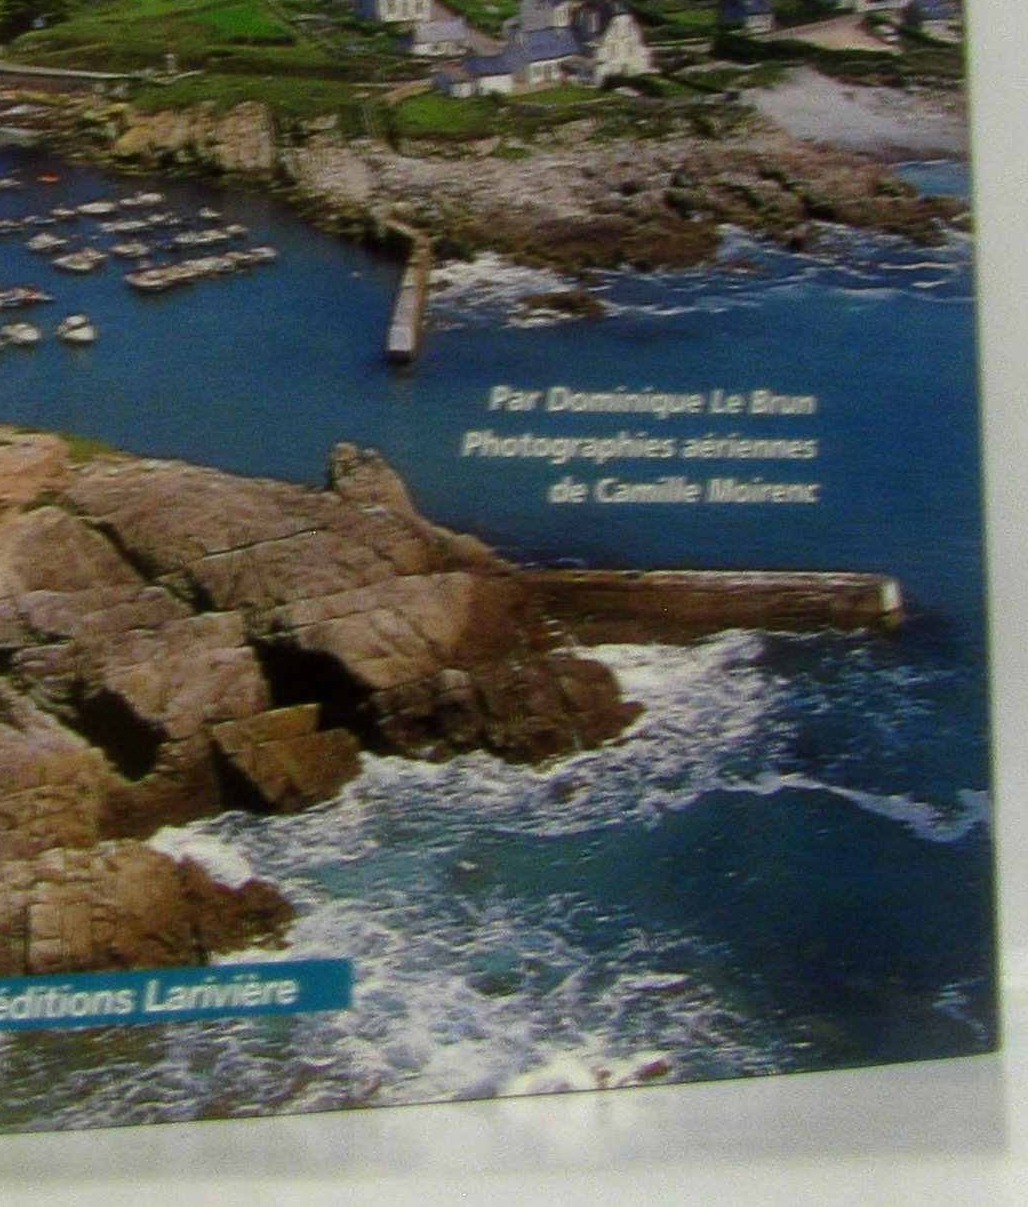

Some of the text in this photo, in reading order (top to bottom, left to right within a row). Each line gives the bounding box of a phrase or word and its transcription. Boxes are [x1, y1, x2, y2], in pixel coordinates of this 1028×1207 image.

[488, 384, 819, 418] Par Dominique Le Brun
[460, 429, 818, 464] Photographies aériennes
[548, 476, 589, 504] de
[593, 477, 701, 504] Camille
[143, 973, 300, 1013] Larivière
